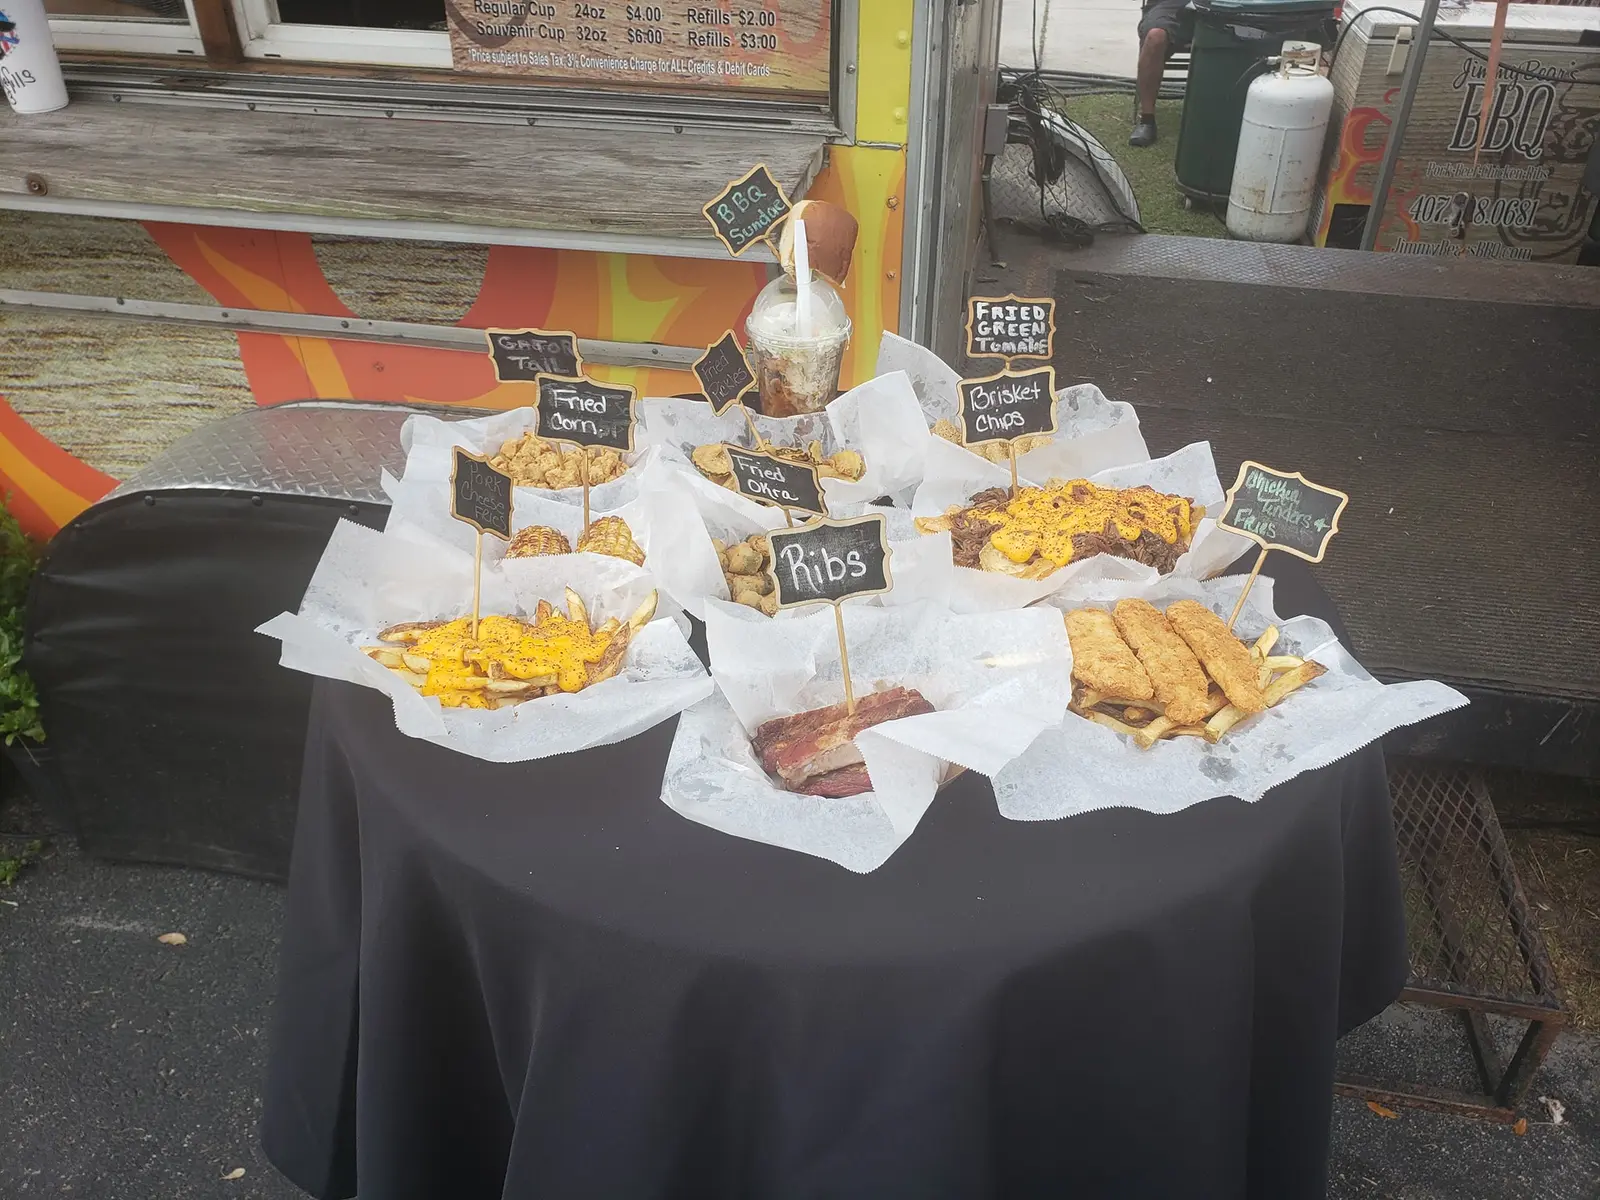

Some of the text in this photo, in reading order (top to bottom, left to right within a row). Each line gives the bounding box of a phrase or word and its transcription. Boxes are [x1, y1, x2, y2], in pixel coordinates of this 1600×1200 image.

[474, 0, 776, 27] Regular Cup 24oz $4.00 Refills $2.00
[476, 20, 777, 49] Souvenir Cup 32oz $6.00 Refills $3.00
[491, 50, 519, 66] subject
[520, 52, 528, 65] to
[529, 52, 549, 66] Sales
[580, 54, 629, 71] Convenience
[629, 57, 657, 74] Charge
[658, 57, 669, 72] for
[670, 58, 686, 73] ALL
[687, 59, 716, 74] Credits
[724, 61, 746, 75] Debit
[747, 62, 770, 77] Cards
[1448, 81, 1556, 159] BBQ
[729, 199, 786, 245] Sundae
[1408, 194, 1540, 228] 407.8.0681
[977, 321, 1046, 336] GREEN
[701, 348, 730, 382] Fried
[707, 367, 748, 402] Pickles
[970, 382, 1042, 411] Brisket
[552, 389, 607, 414] Fried
[975, 409, 1025, 432] Chips
[730, 454, 786, 483] Fried
[779, 543, 867, 594] Ribs
